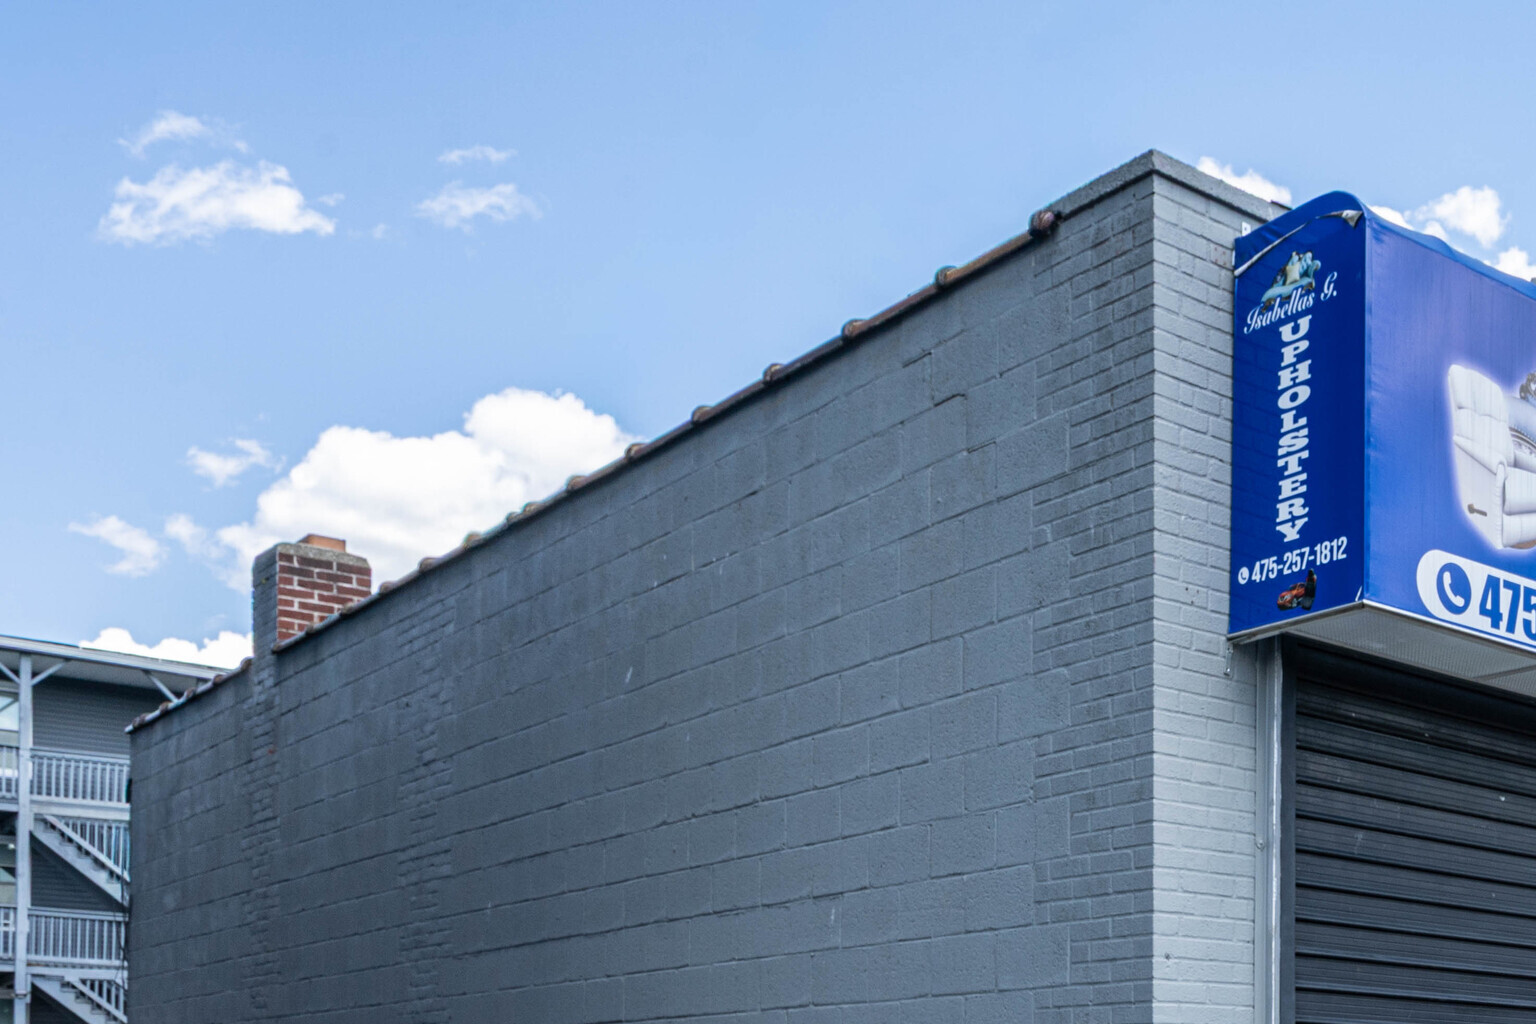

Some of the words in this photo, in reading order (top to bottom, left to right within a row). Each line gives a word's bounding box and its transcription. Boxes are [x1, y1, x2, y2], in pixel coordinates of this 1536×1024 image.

[1320, 271, 1338, 302] G.
[1276, 314, 1313, 542] UPHOLSTERY
[1251, 536, 1348, 583] 475-257-1812
